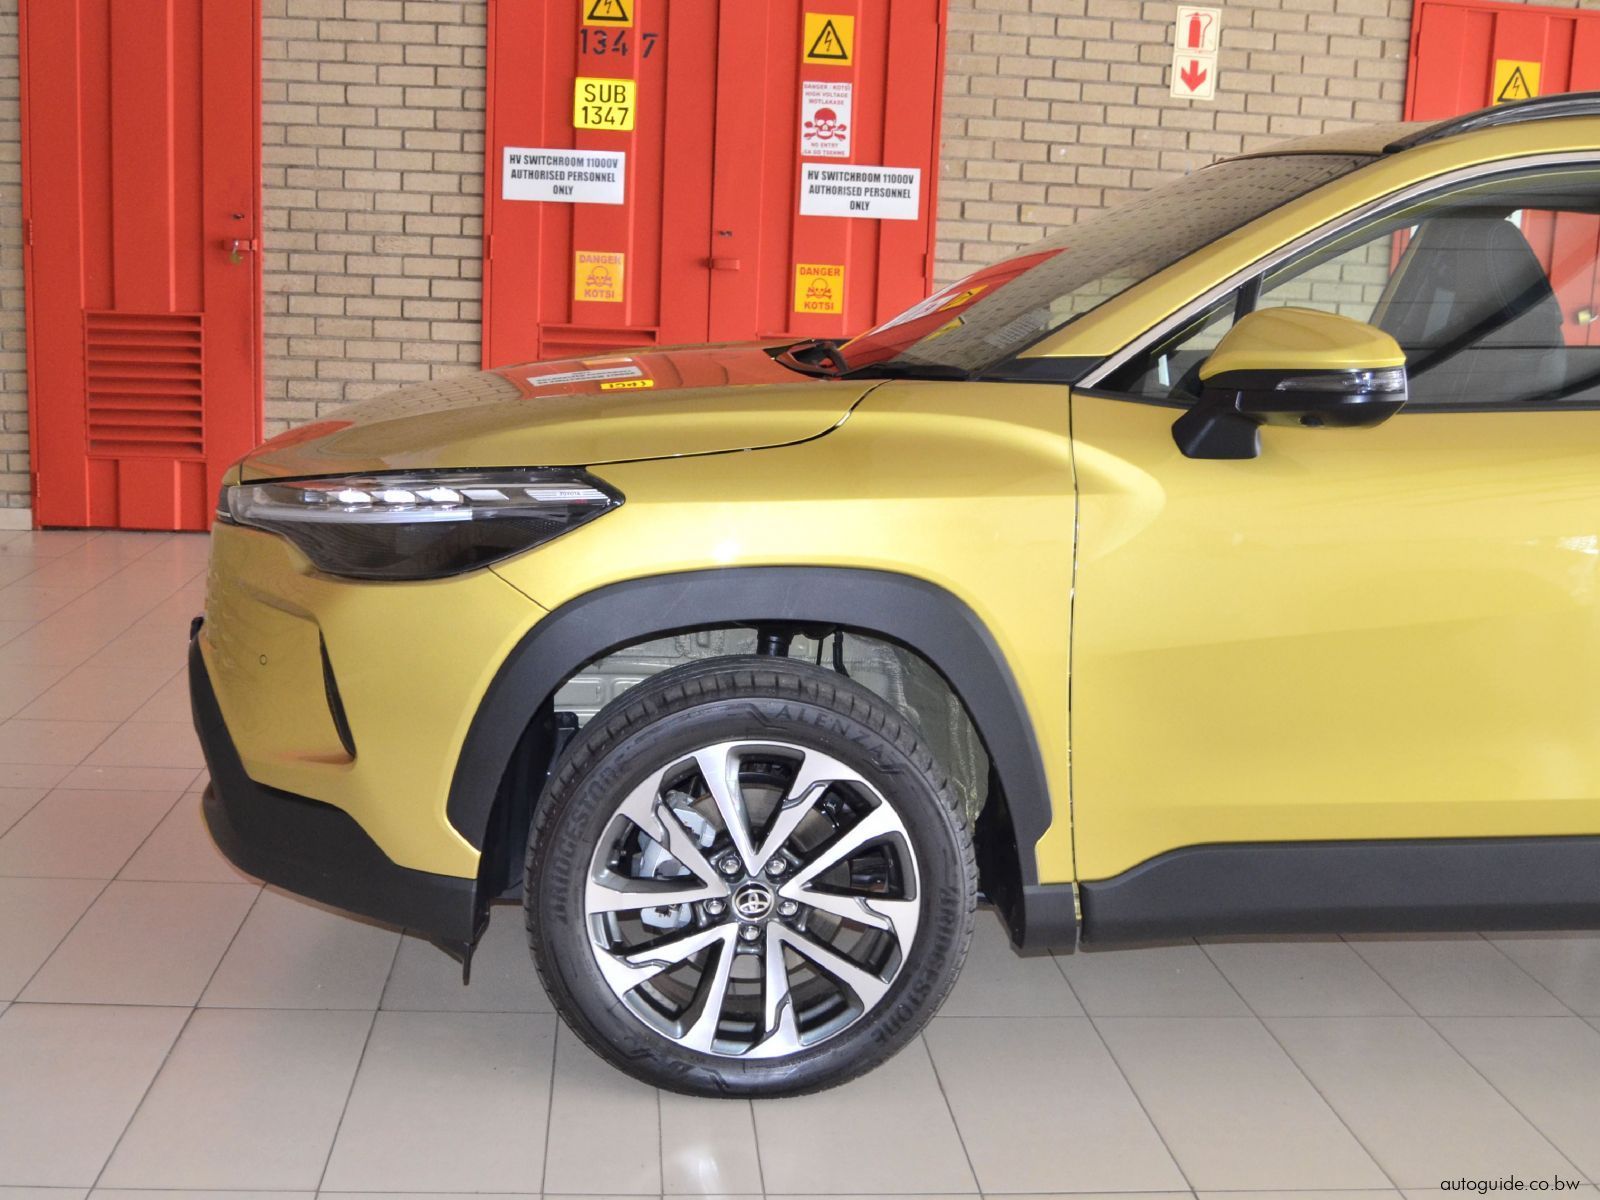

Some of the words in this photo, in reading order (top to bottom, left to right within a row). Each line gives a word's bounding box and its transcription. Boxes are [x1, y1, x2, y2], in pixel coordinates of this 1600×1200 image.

[584, 83, 626, 104] SUB
[582, 106, 629, 125] 1347
[509, 154, 522, 165] HV
[523, 155, 584, 167] SWITCHROOM
[586, 158, 618, 168] 11000V
[511, 169, 565, 181] AUTHORISED
[567, 171, 615, 182] PERSONNEL
[807, 170, 819, 180] HV
[821, 171, 881, 183] SWITCHROOM
[883, 174, 914, 184] 11000V
[553, 185, 573, 195] ONLY
[809, 185, 862, 196] AUTHORISED
[864, 187, 911, 198] PERSONNEL
[849, 200, 870, 210] ONLY
[579, 254, 621, 264] DANGER
[800, 267, 840, 276] DANGER
[584, 289, 615, 298] KOTSI
[804, 301, 834, 310] KOTSI
[776, 704, 886, 761] ALENZA
